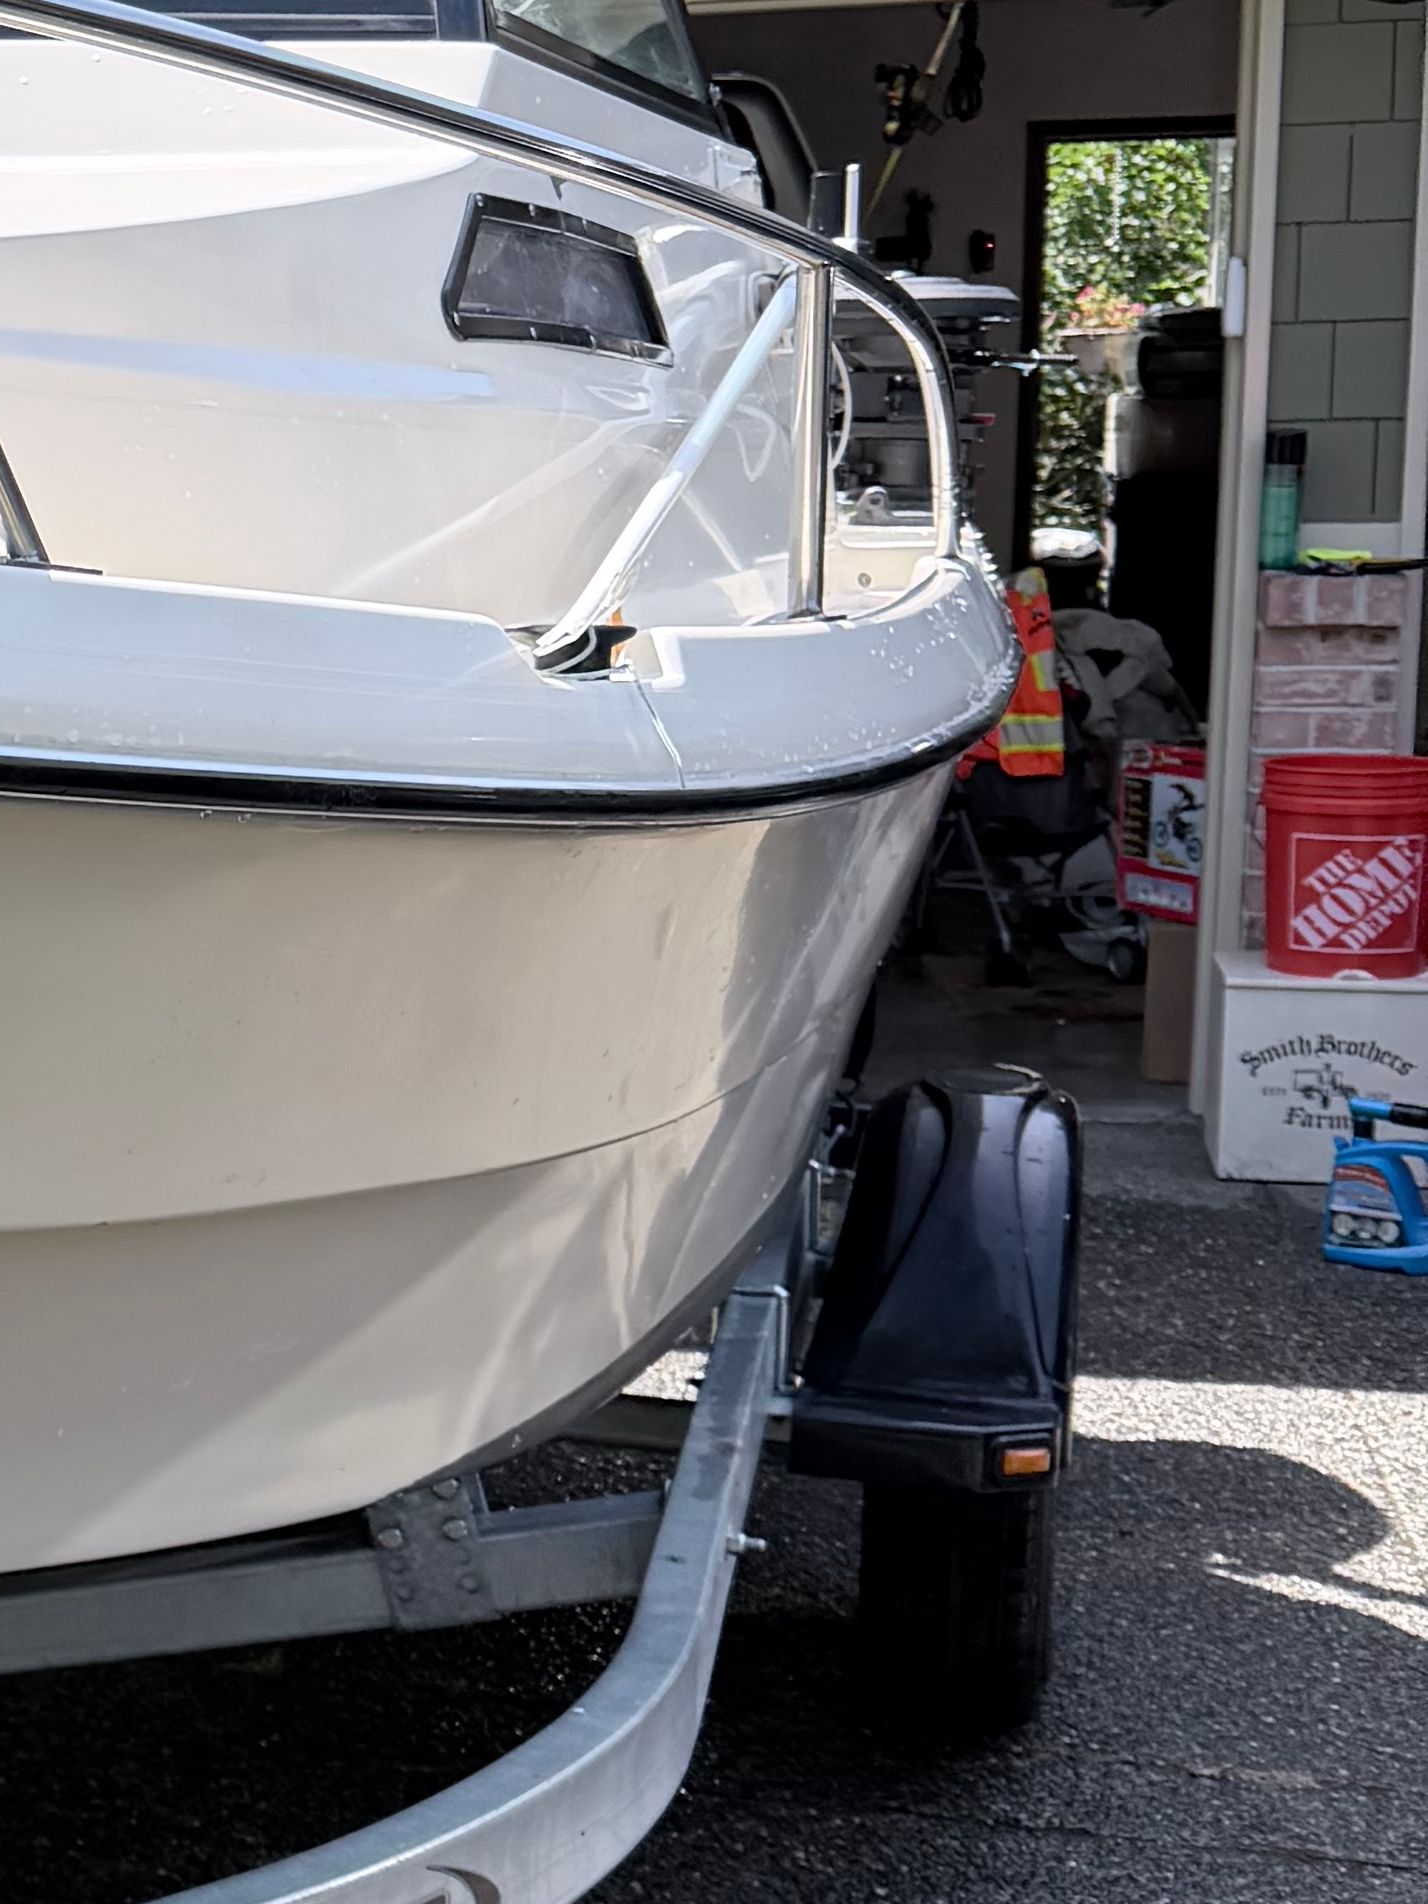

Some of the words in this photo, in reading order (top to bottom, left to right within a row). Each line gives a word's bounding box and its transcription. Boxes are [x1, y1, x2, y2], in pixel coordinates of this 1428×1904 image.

[1292, 836, 1422, 949] HOME
[1301, 848, 1363, 893] THE
[1340, 880, 1416, 950] DEPOT
[1315, 1033, 1418, 1077] Brothers
[1283, 1105, 1352, 1130] Farm
